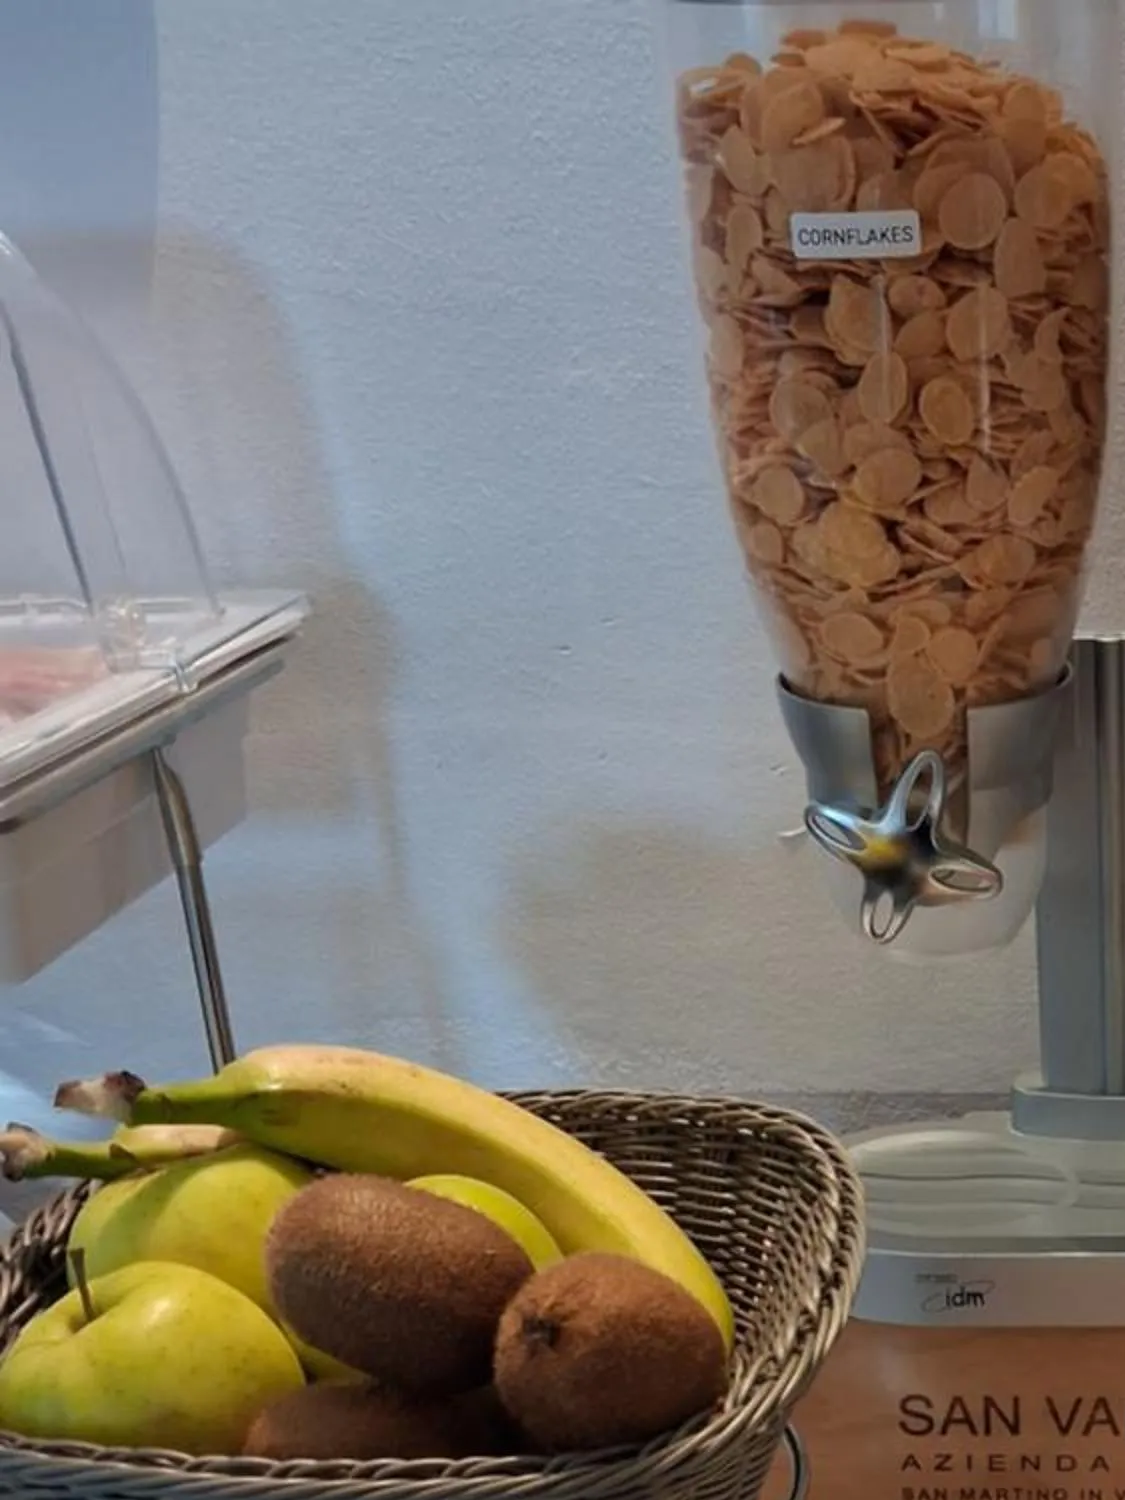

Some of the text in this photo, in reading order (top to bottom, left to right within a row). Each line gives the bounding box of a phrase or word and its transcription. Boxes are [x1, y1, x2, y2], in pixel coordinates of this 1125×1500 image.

[797, 226, 913, 246] CORNFLAKES
[898, 1394, 1021, 1437] SAN
[901, 1454, 1110, 1472] AZIENDA
